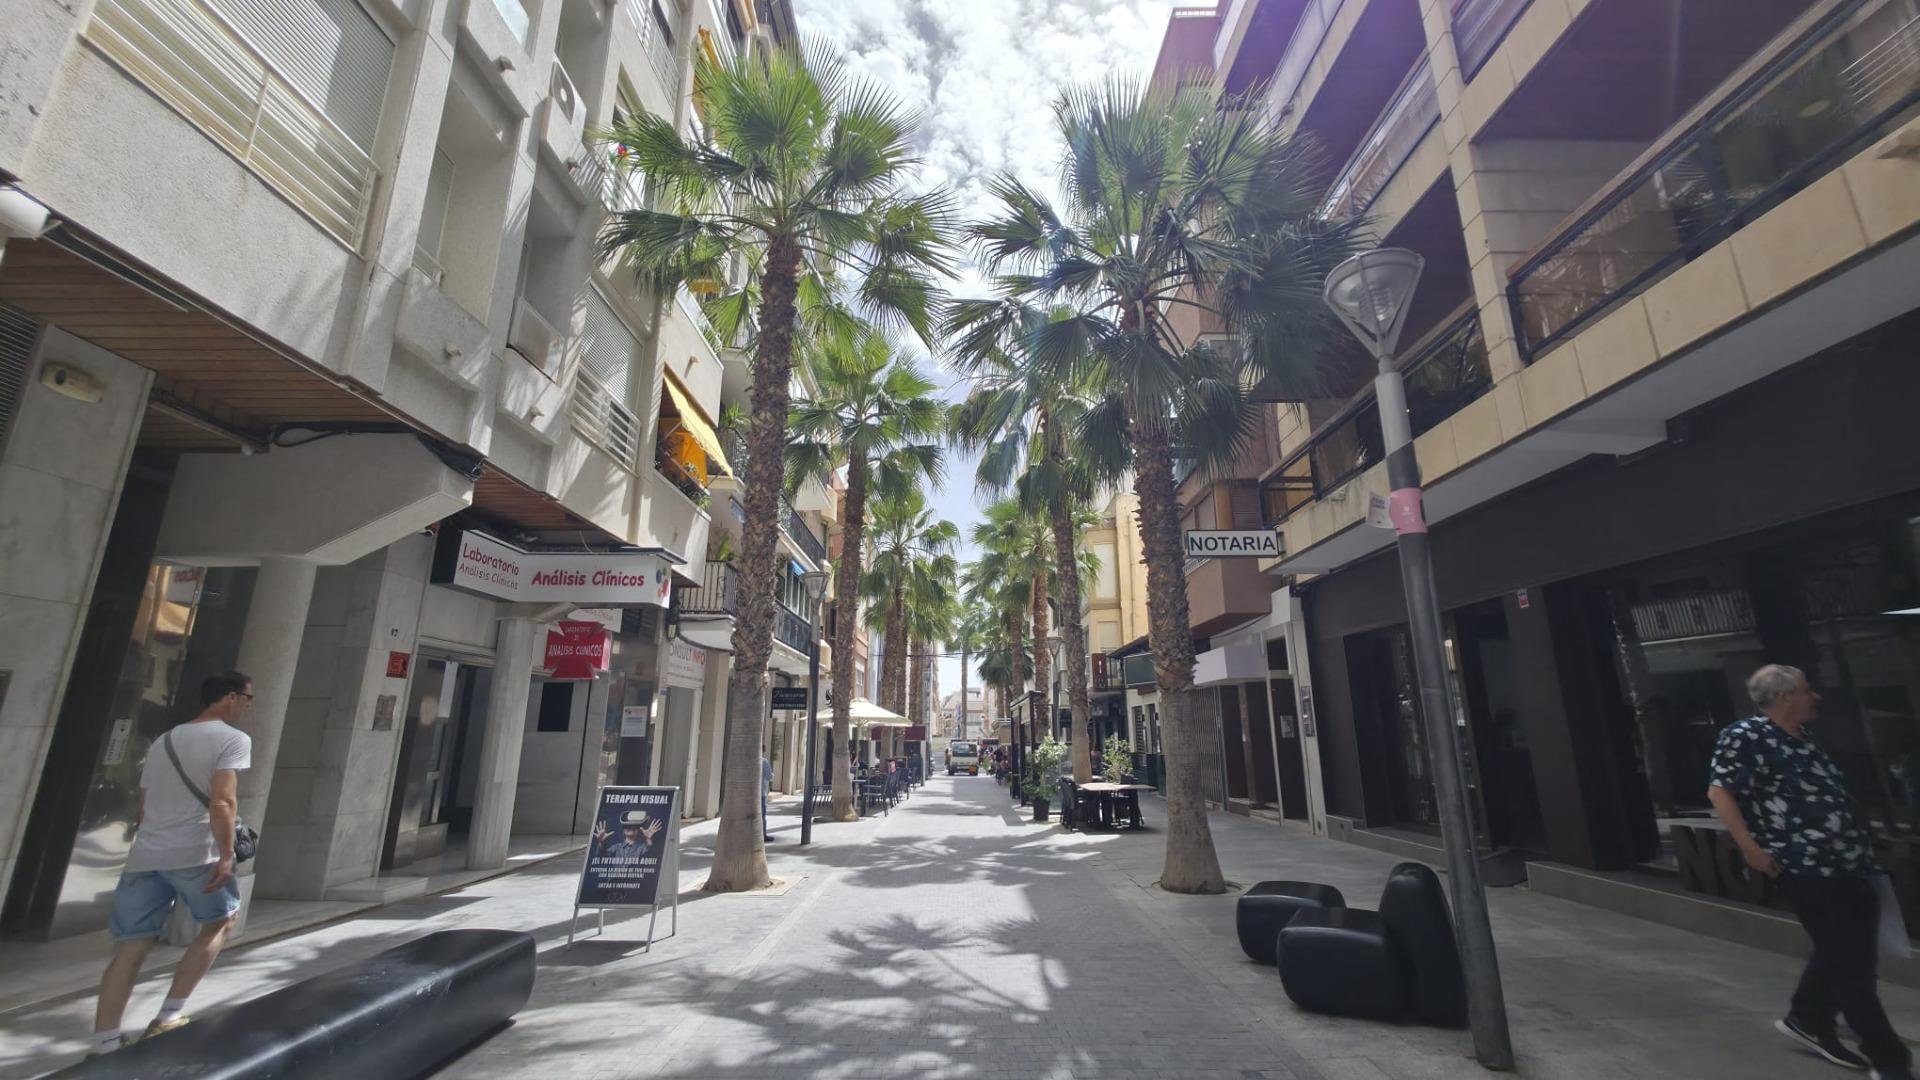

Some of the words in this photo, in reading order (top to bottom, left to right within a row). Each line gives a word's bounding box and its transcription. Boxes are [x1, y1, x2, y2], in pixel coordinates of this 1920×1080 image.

[1190, 536, 1276, 551] NOTARIA
[462, 543, 520, 576] Laboratorio
[531, 569, 587, 586] Análisis
[592, 569, 645, 586] Clínicos
[606, 794, 639, 804] TERAPIA
[640, 795, 669, 805] VISUAL
